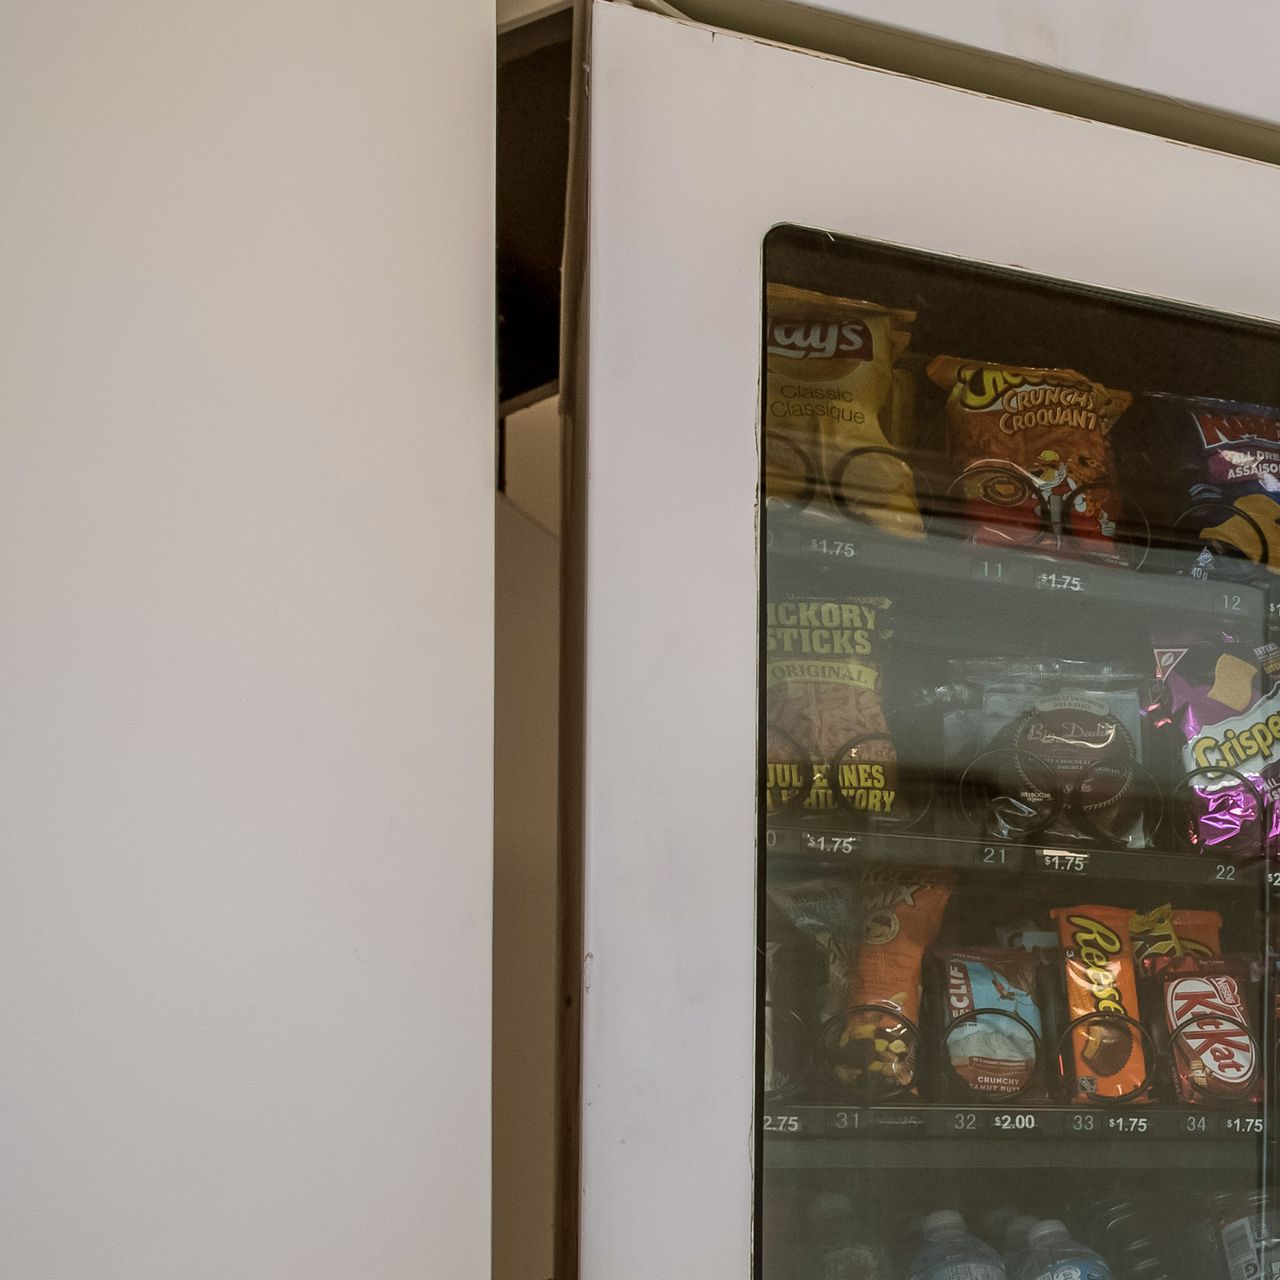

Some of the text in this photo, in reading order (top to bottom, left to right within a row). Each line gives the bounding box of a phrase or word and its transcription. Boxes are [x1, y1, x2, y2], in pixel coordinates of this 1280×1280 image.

[767, 320, 864, 359] ay's
[780, 384, 854, 403] Classic
[770, 400, 866, 425] Classique
[998, 406, 1098, 435] CROQUANT
[811, 537, 856, 558] $1.75
[980, 560, 1081, 592] 11 $1.75
[1222, 594, 1241, 611] 12
[767, 602, 877, 631] ICKORY
[771, 664, 868, 684] ORIGINAL
[807, 835, 855, 855] $1.75
[983, 847, 1085, 871] 21 $1.75
[1215, 864, 1236, 881] 22
[949, 963, 970, 1009] CLIF
[977, 1076, 1021, 1086] CRUNCHY
[835, 1112, 860, 1129] 31
[954, 1113, 1036, 1130] 32 $2.00
[1072, 1114, 1148, 1133] 33 $1.75
[1186, 1116, 1264, 1133] 34 $1.75
